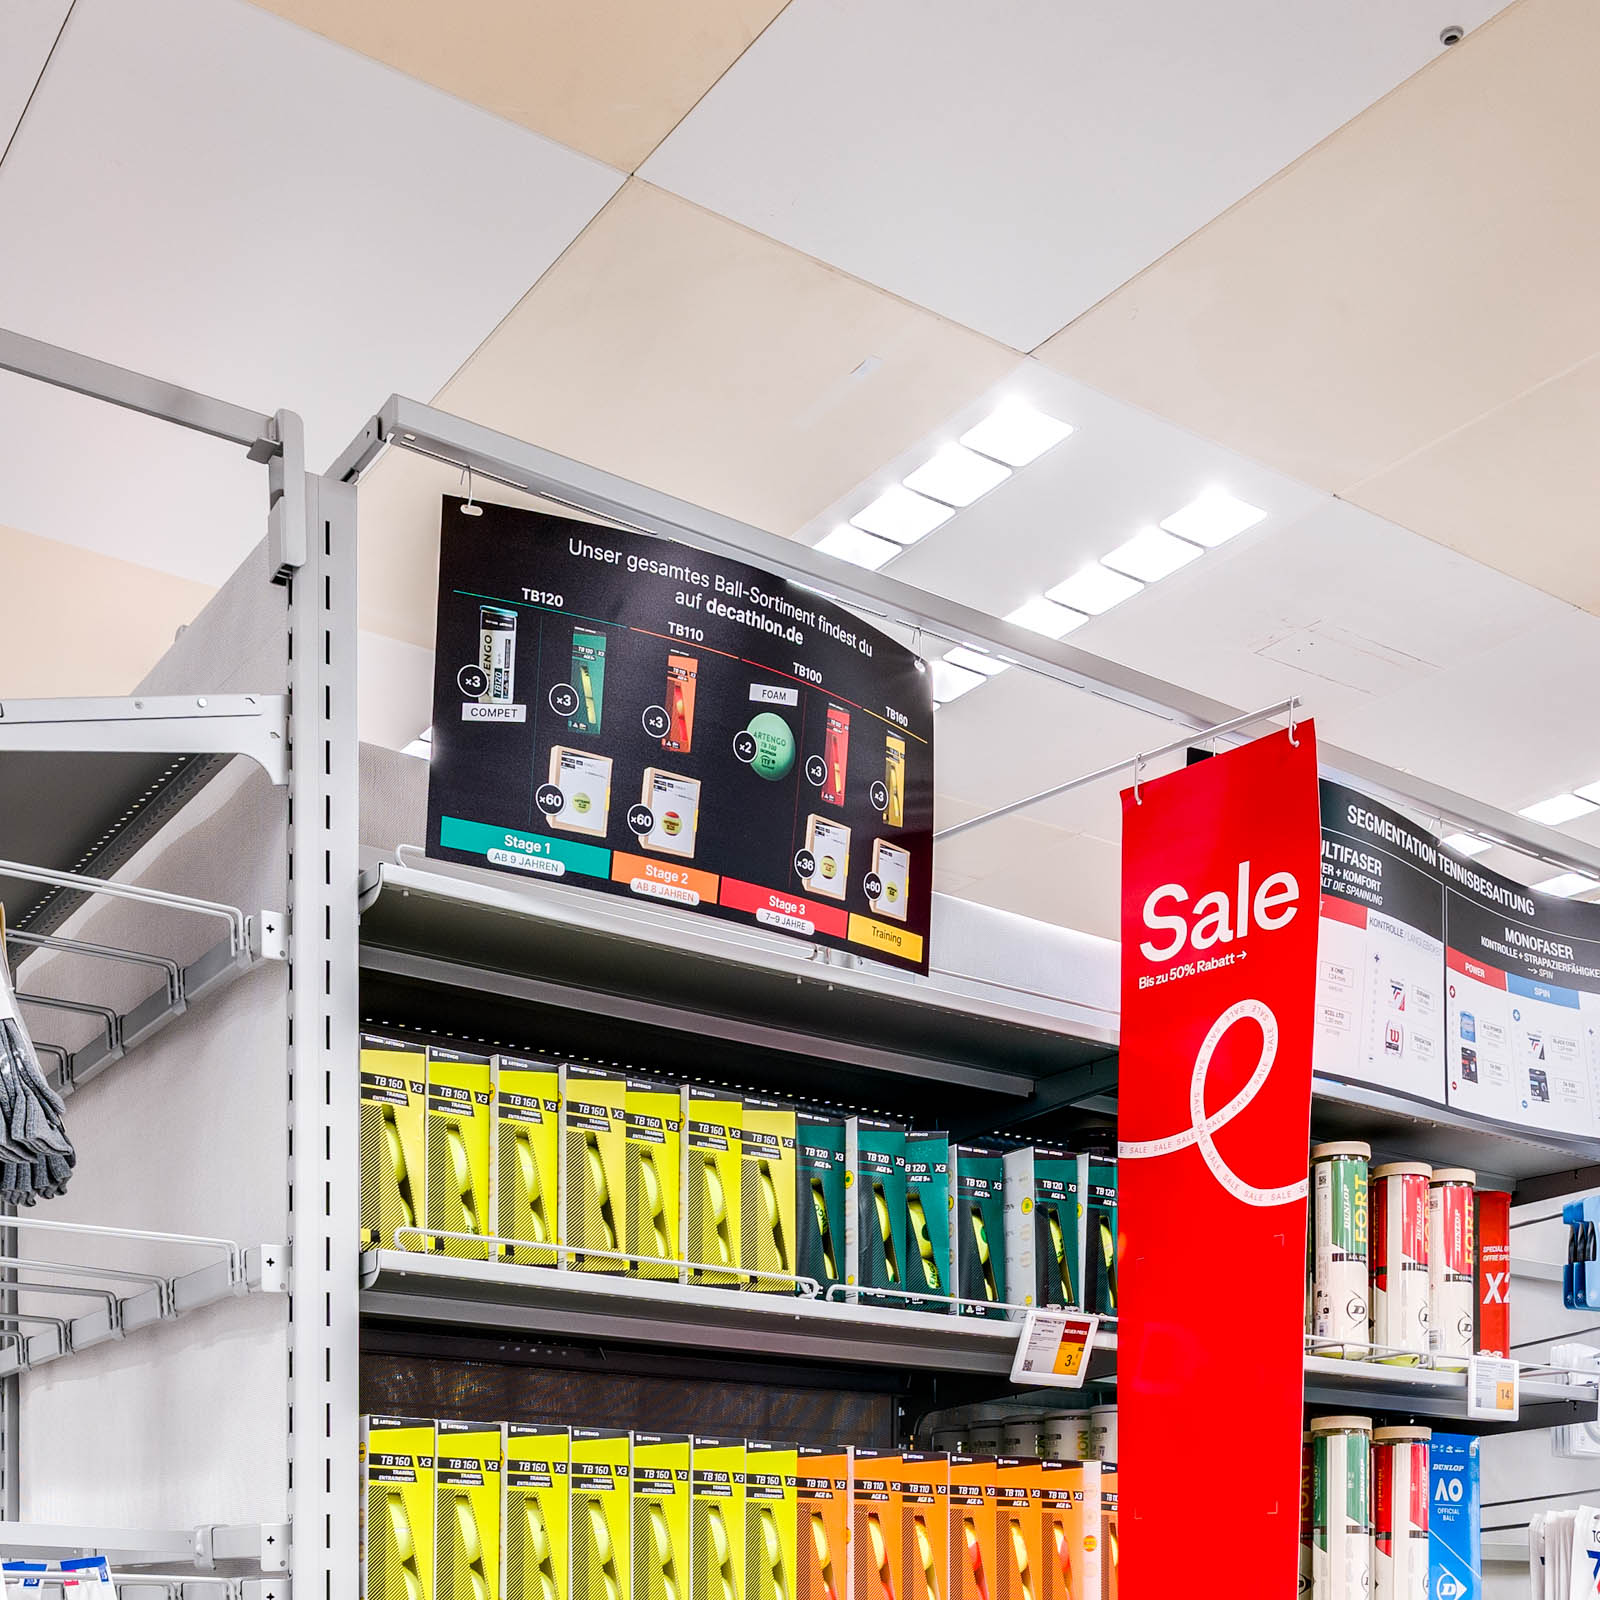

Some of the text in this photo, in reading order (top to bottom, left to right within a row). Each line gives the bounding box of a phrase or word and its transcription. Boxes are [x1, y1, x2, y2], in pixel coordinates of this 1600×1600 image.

[521, 587, 564, 607] TB120
[568, 538, 873, 657] Unser gesamtes Ball-Sortiment findest du
[674, 590, 804, 646] auf decathlon.de
[667, 621, 704, 642] TB110
[793, 661, 823, 684] TB100
[761, 689, 787, 701] FOAM
[470, 707, 518, 719] COMPET
[885, 705, 908, 727] TB160
[504, 834, 551, 854] Stage 1
[494, 852, 560, 873] AB 9 JAHREN
[1321, 840, 1383, 877] ULTIFASER
[1347, 805, 1536, 916] SEGMENTATION TENNISBESAITUNG
[645, 864, 689, 885] Stage 2
[1343, 870, 1382, 892] KOMFORT
[636, 881, 695, 903] AB 8 JAHREN
[1333, 880, 1384, 906] DIE SPANNUNG
[769, 896, 806, 914] Stage 3
[1139, 860, 1300, 962] Sale
[782, 915, 806, 931] JAHRE
[1369, 916, 1404, 938] KONTROLLE
[872, 926, 902, 946] Training
[1504, 927, 1574, 960] MONOFASER
[1481, 935, 1518, 959] KONTROLLE
[1139, 952, 1236, 990] Bis zu 50% Rabatt
[1465, 962, 1485, 978] POWER
[1539, 968, 1554, 980] SPIN
[1534, 987, 1550, 999] SPIN
[411, 1083, 423, 1094] X3
[1354, 1175, 1367, 1243] FORT
[419, 1458, 432, 1468] X3
[1433, 1464, 1465, 1472] DUNLOP
[1437, 1508, 1460, 1516] OFFICIAL
